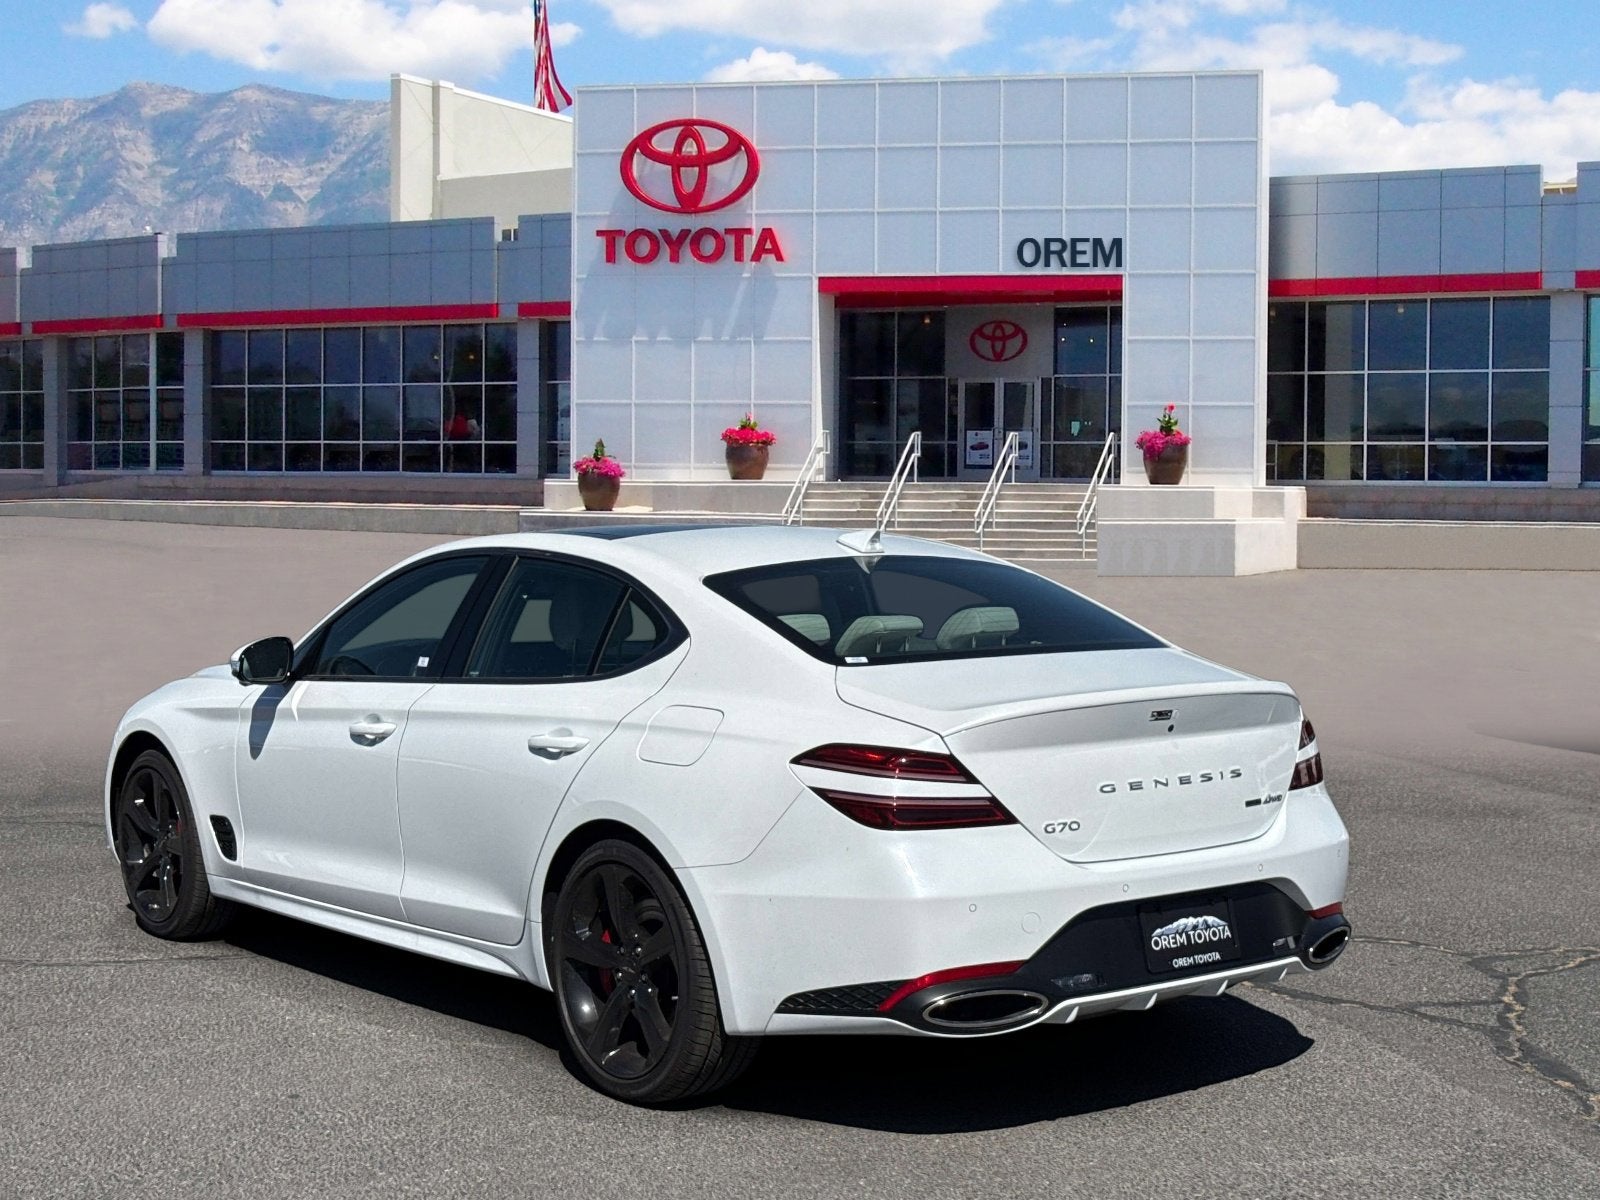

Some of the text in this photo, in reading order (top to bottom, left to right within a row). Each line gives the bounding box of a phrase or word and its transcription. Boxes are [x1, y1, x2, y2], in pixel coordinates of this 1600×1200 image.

[596, 227, 785, 264] TOYOTA
[1017, 237, 1123, 268] OREM
[1099, 768, 1243, 794] GENESIS
[1043, 820, 1081, 834] G70
[1151, 925, 1232, 951] OREM TOYOTA
[1172, 952, 1221, 968] OREM TOYOTA
